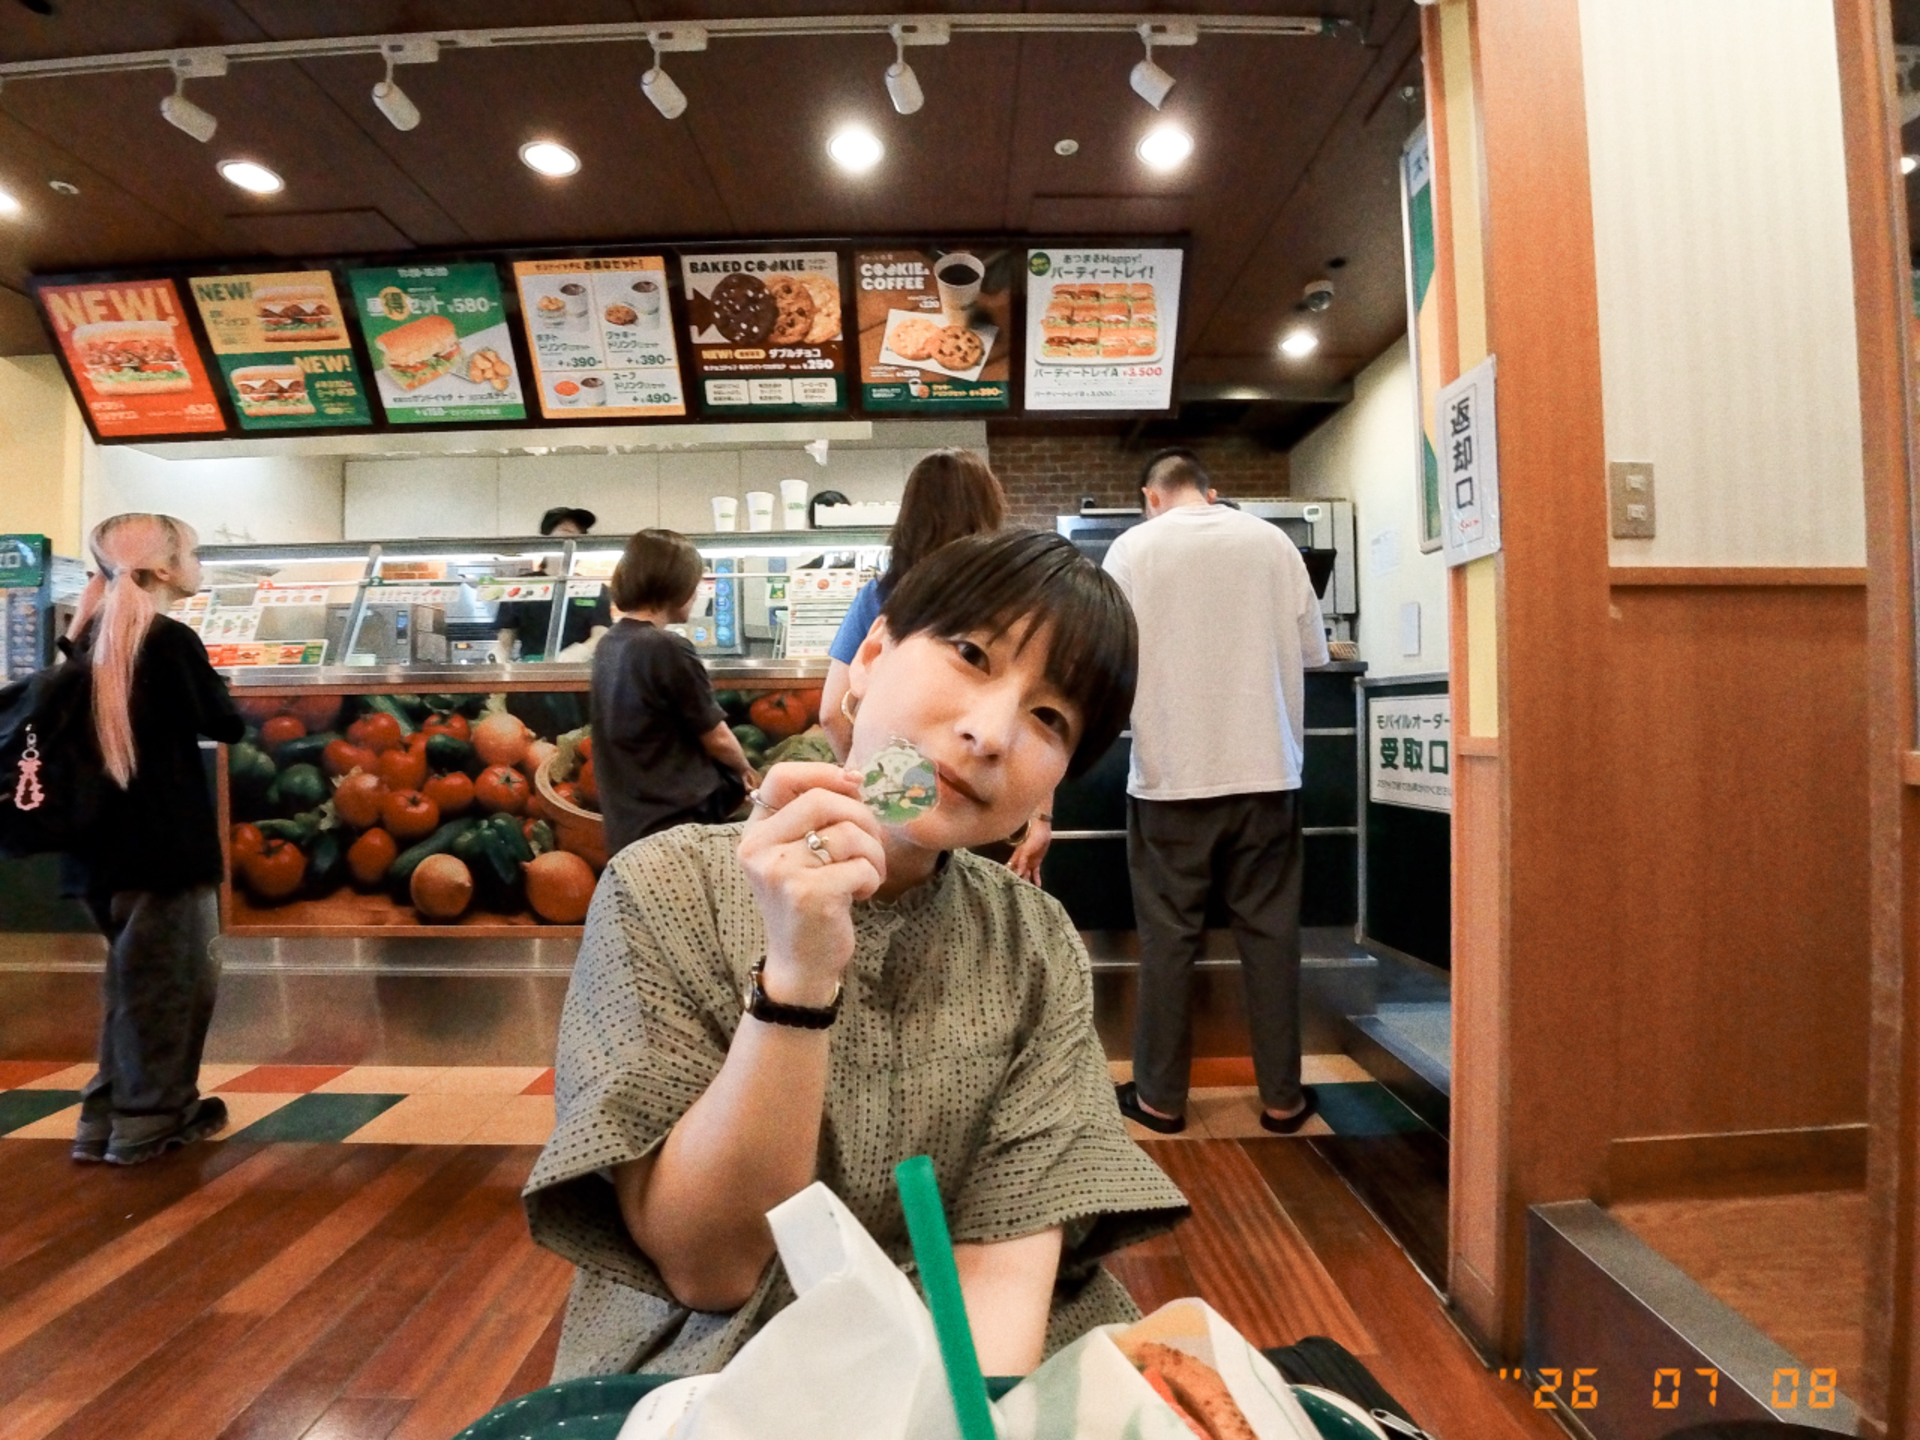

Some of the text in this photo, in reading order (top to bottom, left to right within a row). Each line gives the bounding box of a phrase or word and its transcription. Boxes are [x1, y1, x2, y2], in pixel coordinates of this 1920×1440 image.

[689, 260, 742, 274] BAKED
[744, 258, 805, 272] COOKIE
[1051, 266, 1155, 280] パーティートレイ!
[861, 276, 925, 291] COFFEE
[47, 287, 180, 332] NEW!
[293, 355, 353, 374] NEW!
[1451, 396, 1475, 510] 返却口
[1380, 736, 1449, 775] 受取口
